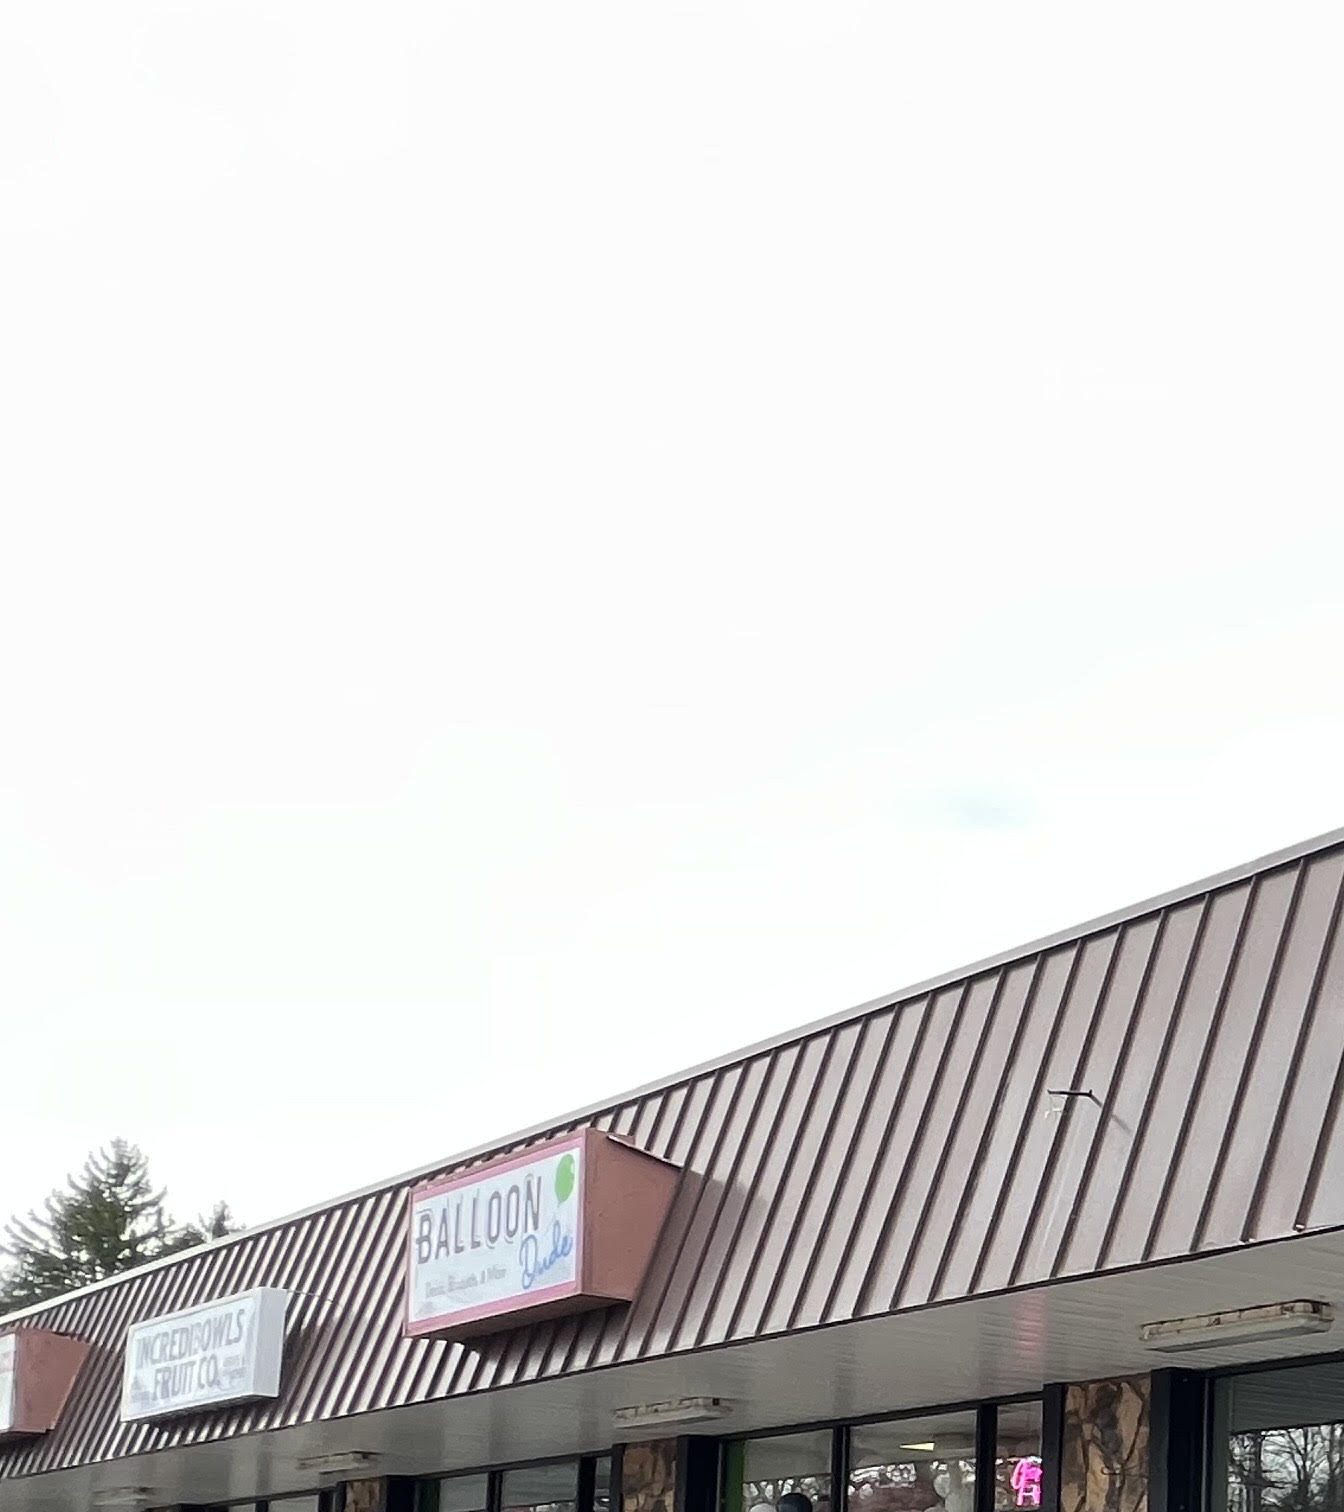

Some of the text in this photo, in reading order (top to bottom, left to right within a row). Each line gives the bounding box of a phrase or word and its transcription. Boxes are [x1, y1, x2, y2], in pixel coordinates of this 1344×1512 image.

[416, 1178, 542, 1265] BALLOON
[518, 1219, 574, 1289] Dude
[151, 1360, 197, 1402] FRUIT
